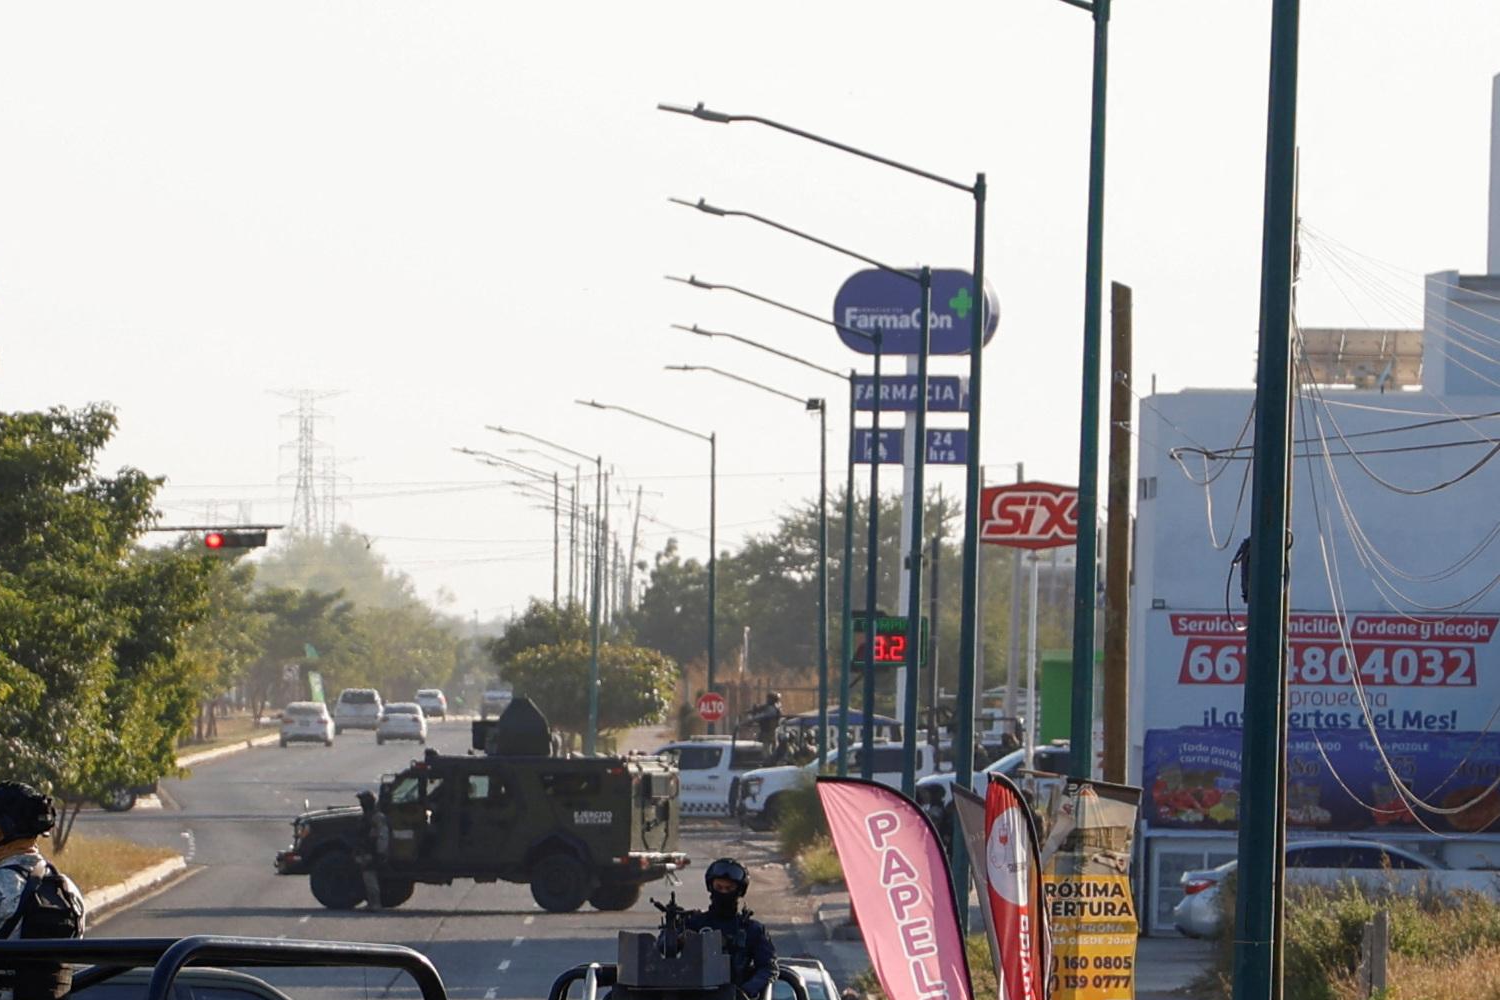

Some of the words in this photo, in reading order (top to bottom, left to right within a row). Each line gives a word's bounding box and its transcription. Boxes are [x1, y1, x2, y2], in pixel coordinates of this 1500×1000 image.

[933, 432, 952, 446] 24
[929, 446, 956, 461] hrs
[1356, 620, 1417, 636] Ordene
[1420, 624, 1430, 639] y
[1434, 621, 1489, 639] Recoja
[1189, 645, 1246, 682] 66
[1359, 648, 1472, 685] 4032
[700, 701, 724, 714] ALTO
[1288, 690, 1387, 709] provecha
[1402, 711, 1457, 730] Mes!
[1043, 879, 1125, 898] RÓXIMA
[1051, 901, 1132, 917] ERTURA
[1064, 956, 1088, 969] 160
[1093, 956, 1132, 969] 0805
[1064, 975, 1088, 988] 139
[1092, 975, 1131, 989] 0777
